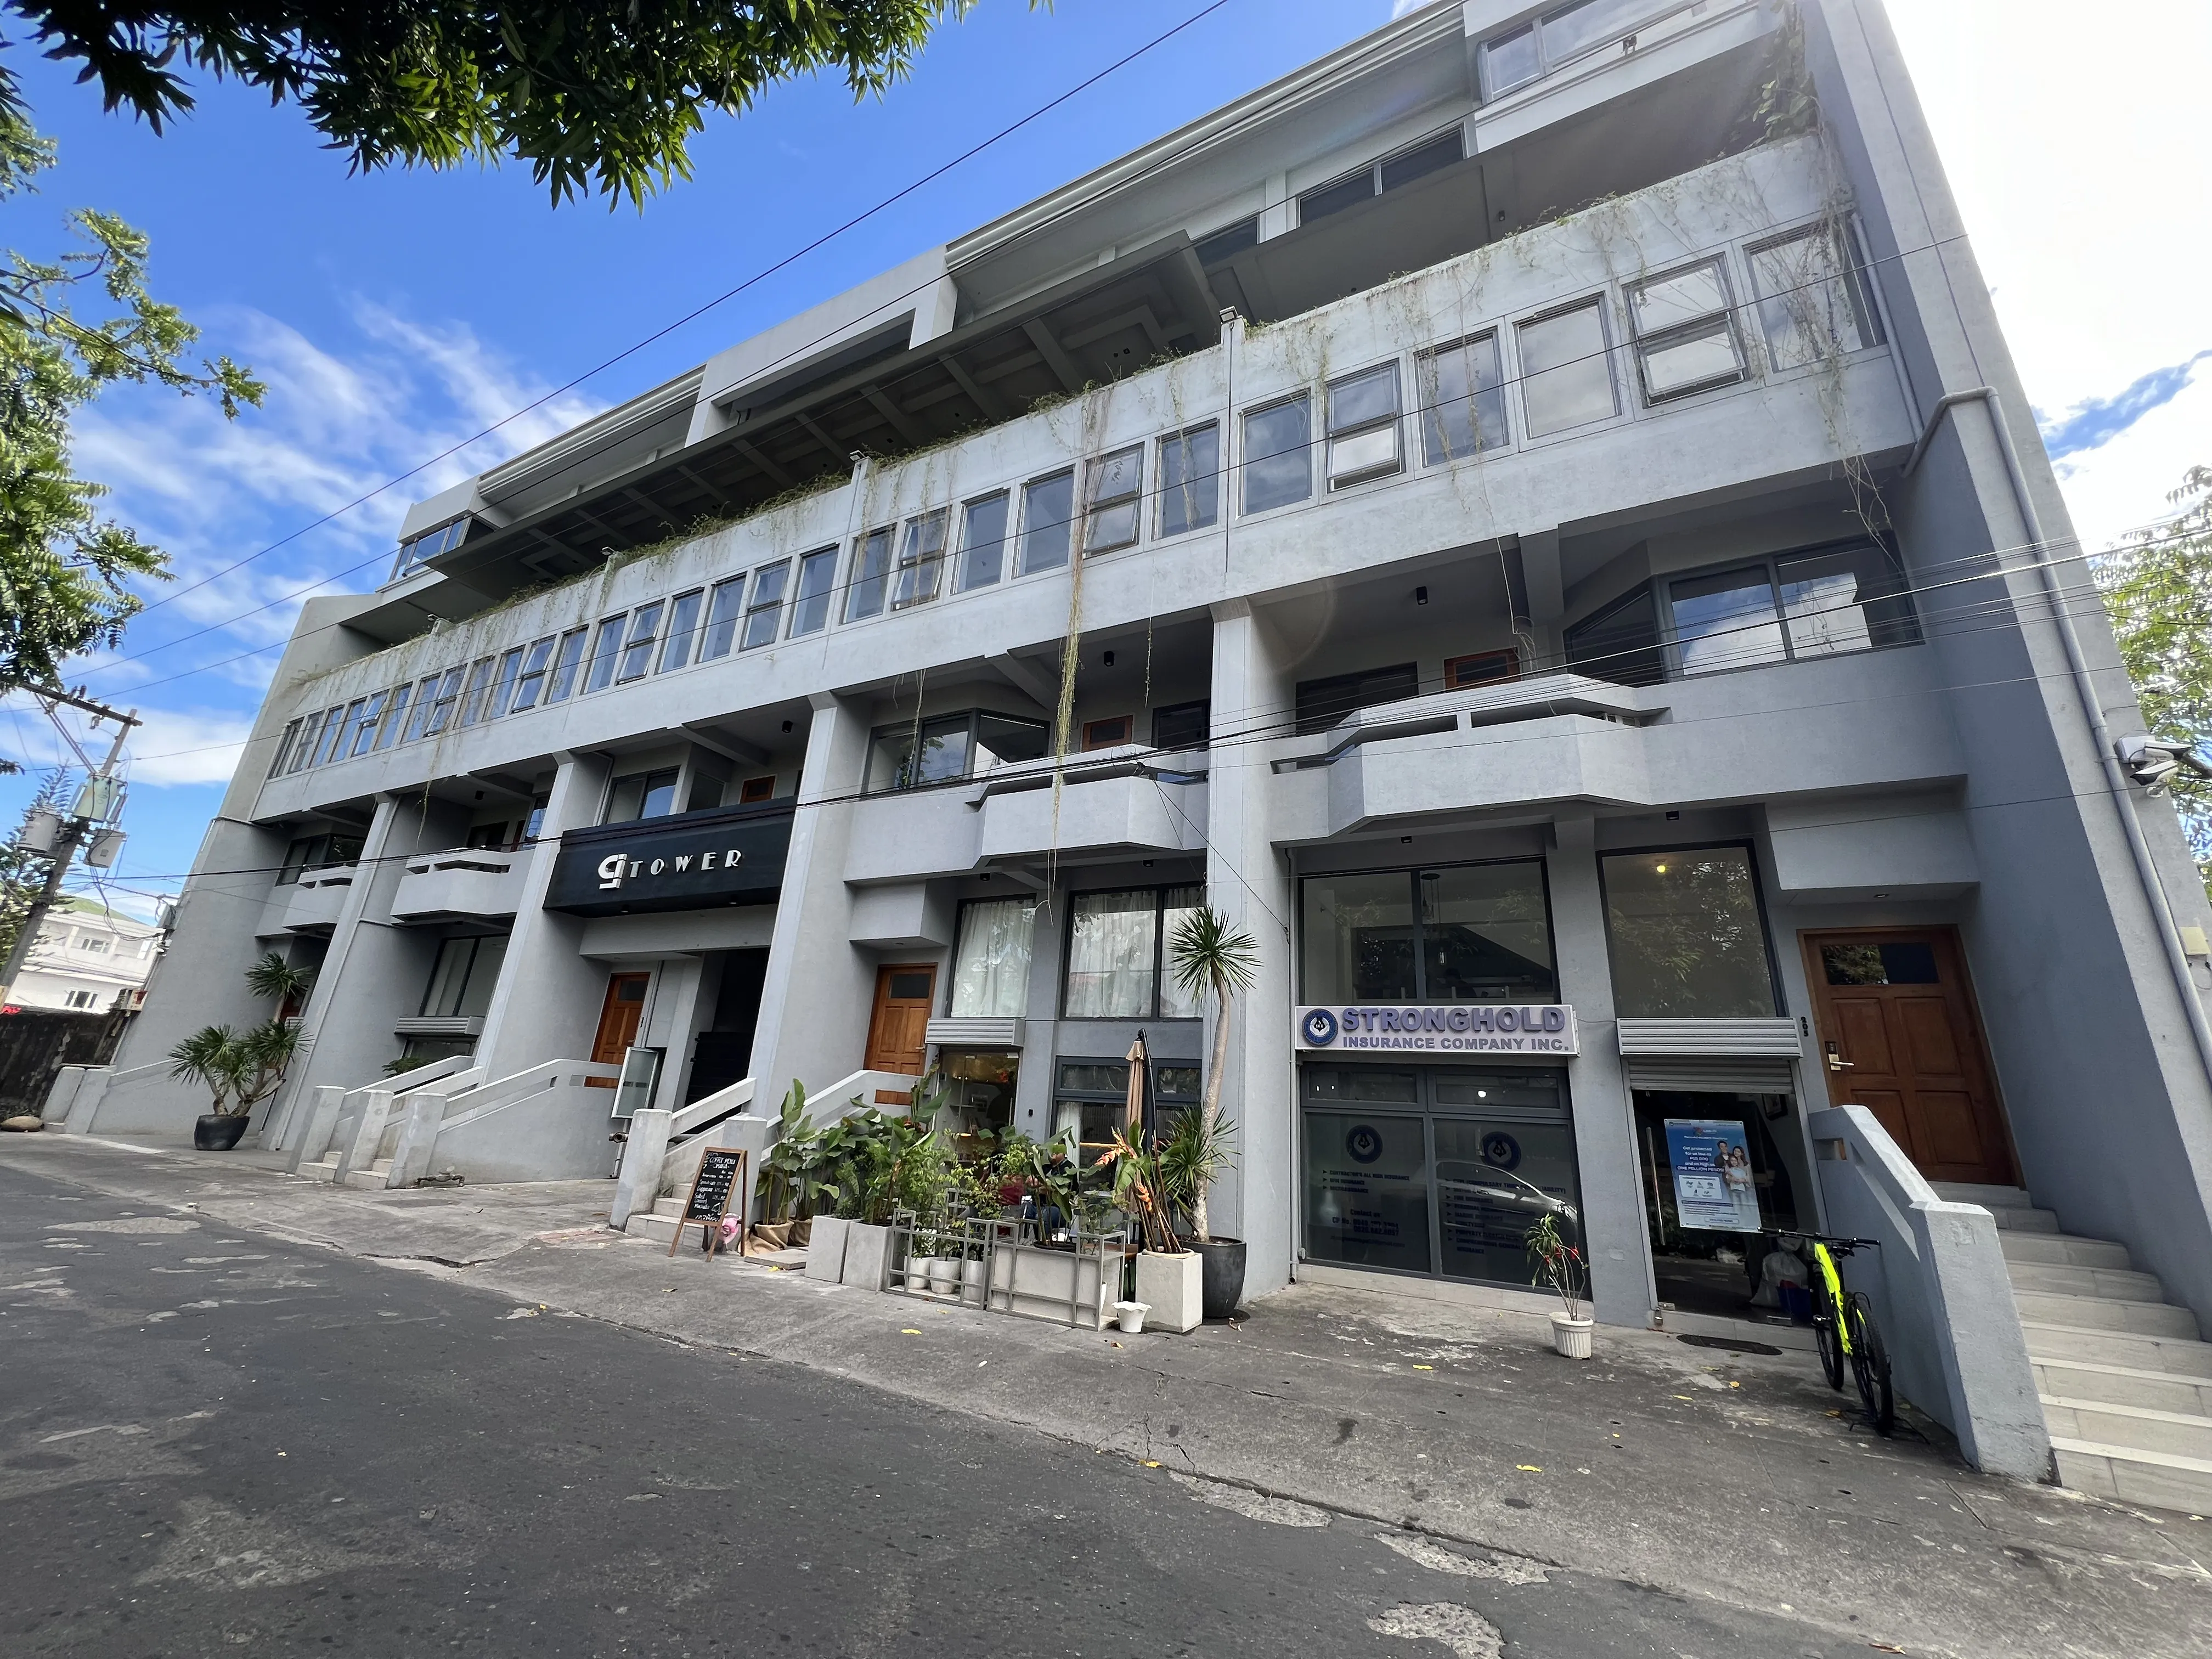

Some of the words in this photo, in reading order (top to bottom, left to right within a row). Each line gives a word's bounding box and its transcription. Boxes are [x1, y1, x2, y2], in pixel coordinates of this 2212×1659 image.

[1342, 1007, 1565, 1032] STRONGHOLD
[1342, 1036, 1435, 1049] INSURANCE
[1440, 1037, 1525, 1050] COMPANY
[1531, 1038, 1569, 1051] INC.
